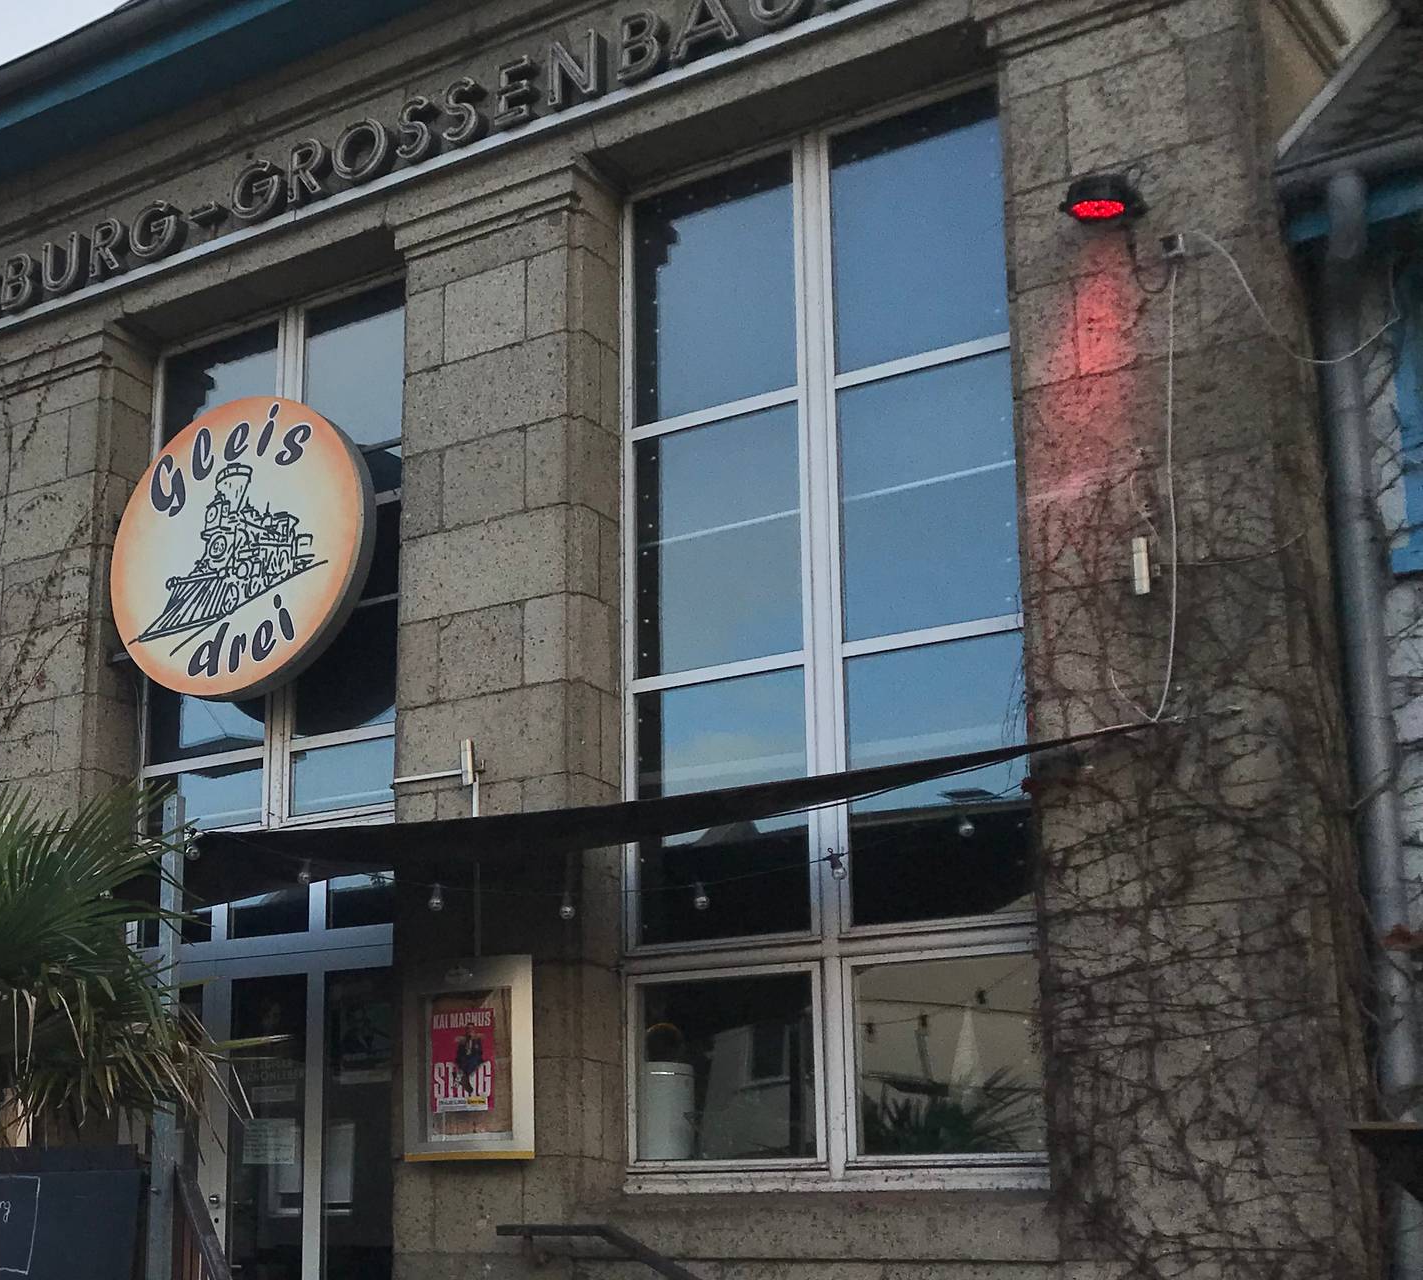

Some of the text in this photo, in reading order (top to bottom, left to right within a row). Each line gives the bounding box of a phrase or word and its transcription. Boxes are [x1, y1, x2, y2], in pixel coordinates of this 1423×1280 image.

[150, 402, 312, 517] Gleis
[185, 593, 295, 678] drei
[433, 1014, 448, 1029] KAI
